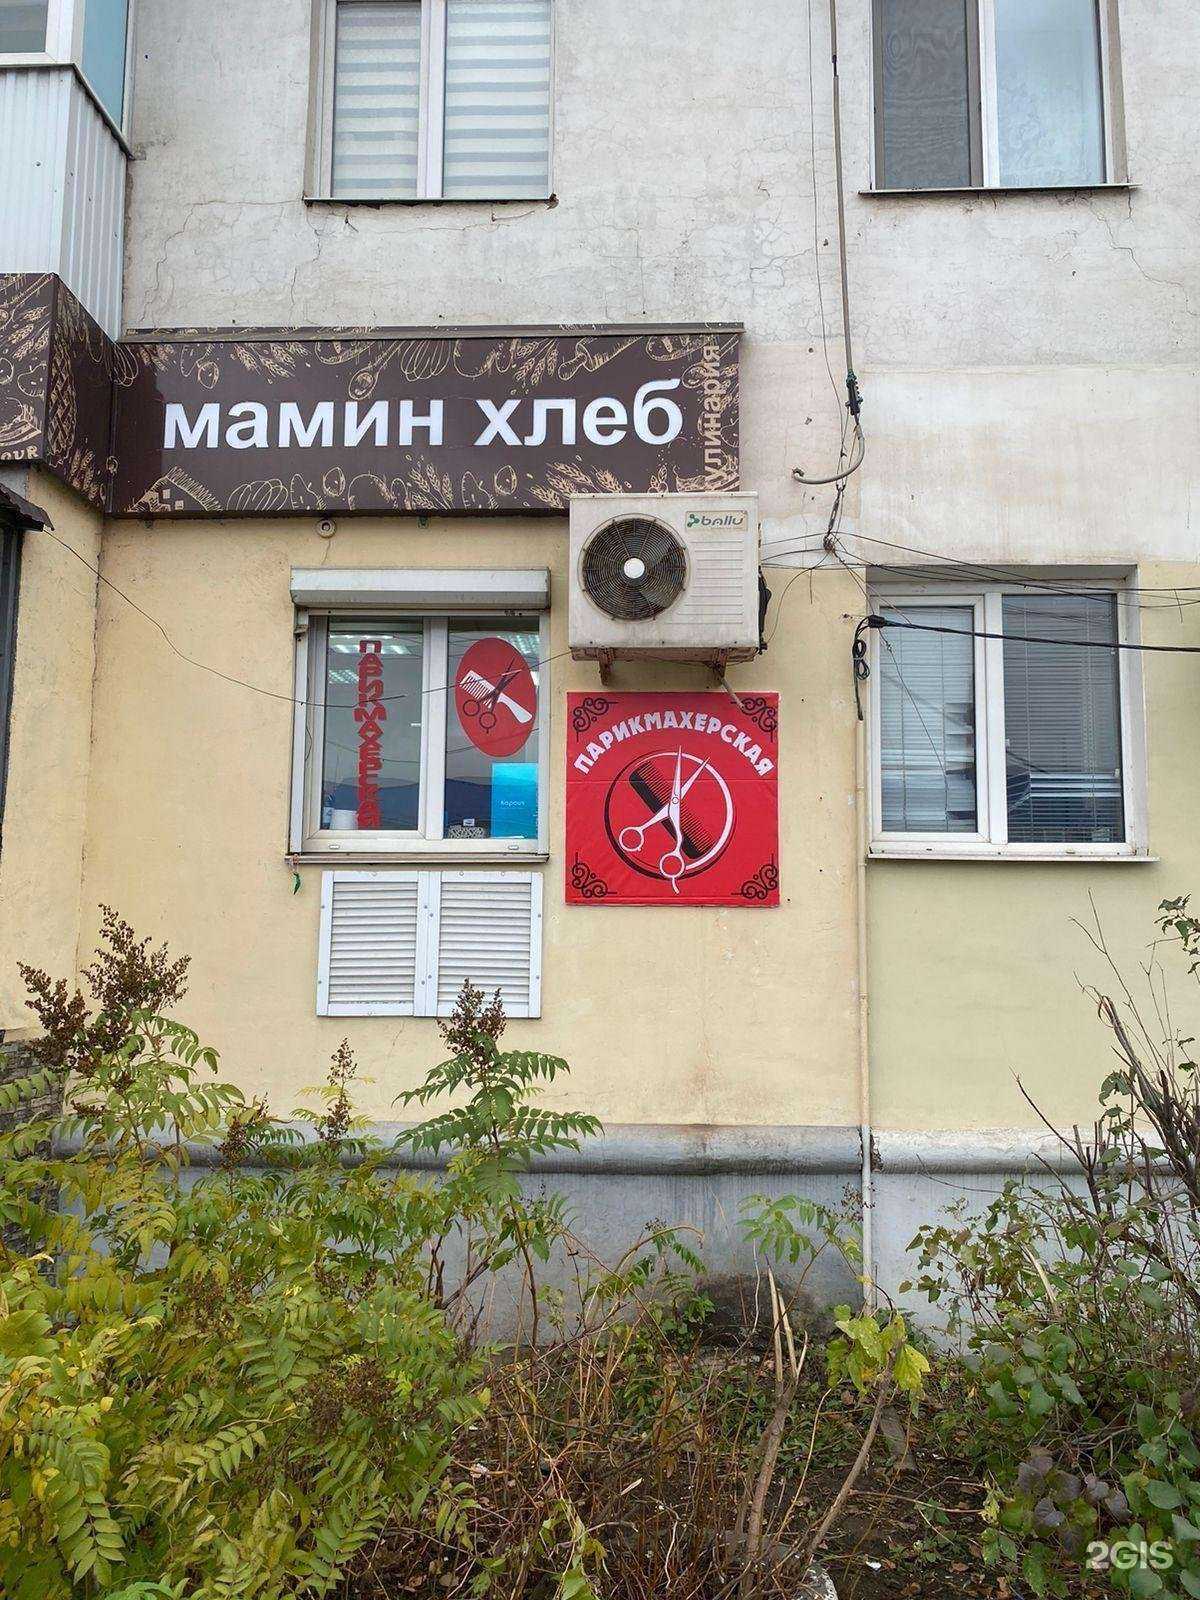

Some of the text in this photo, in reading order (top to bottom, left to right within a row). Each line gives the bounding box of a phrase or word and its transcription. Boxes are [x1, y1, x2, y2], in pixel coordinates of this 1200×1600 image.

[163, 378, 684, 450] мамин хлеб
[702, 345, 728, 490] улинария
[573, 710, 775, 777] ПАРИКМАХЕРСКАЯ
